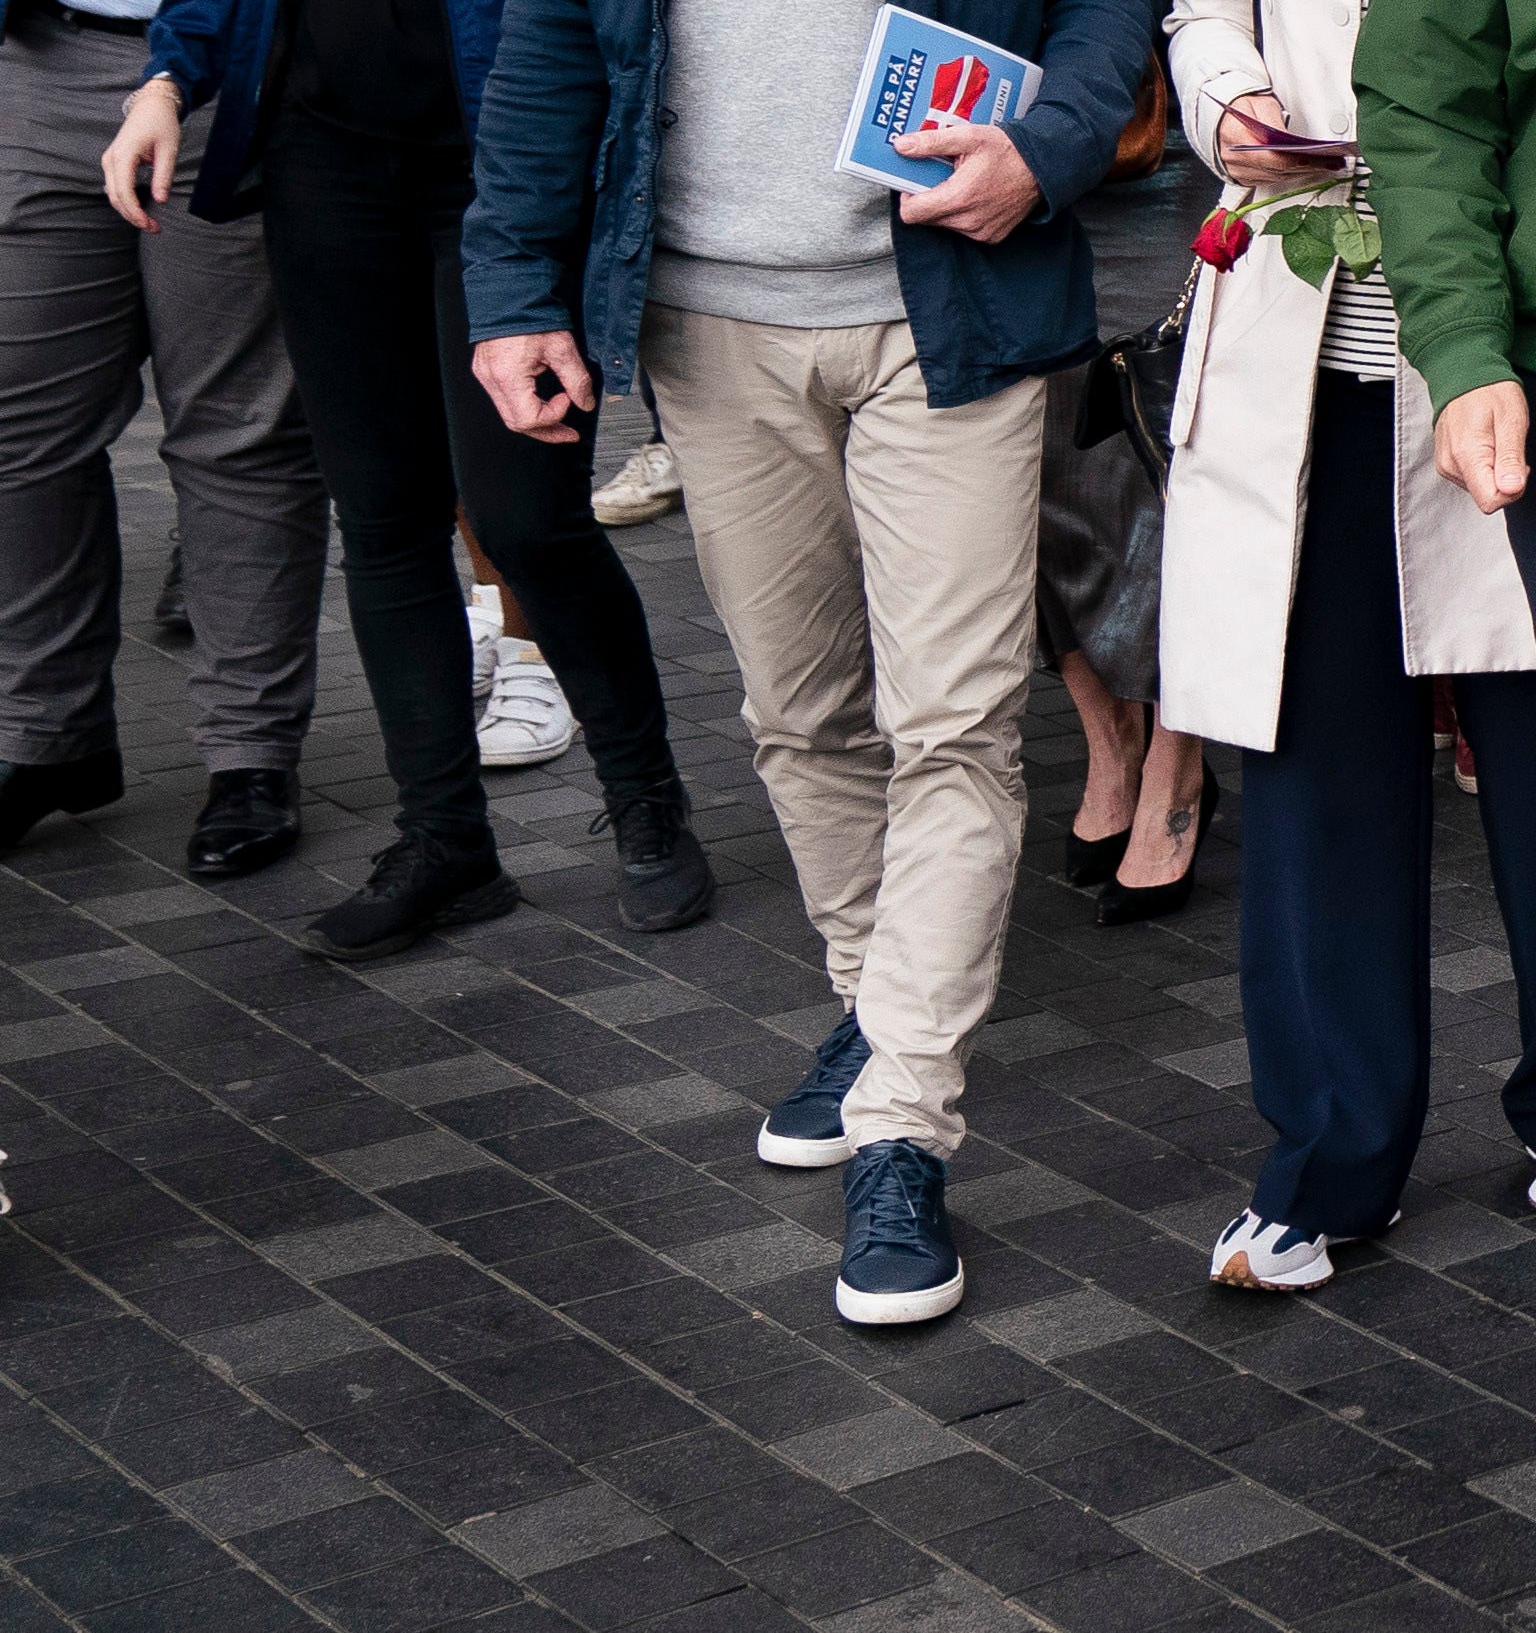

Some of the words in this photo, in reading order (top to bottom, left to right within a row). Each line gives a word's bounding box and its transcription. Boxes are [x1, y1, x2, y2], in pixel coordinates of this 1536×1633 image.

[877, 88, 896, 126] PAS
[889, 61, 906, 86] PÅ
[888, 53, 926, 145] DANMARK
[995, 85, 1009, 115] JUNI
